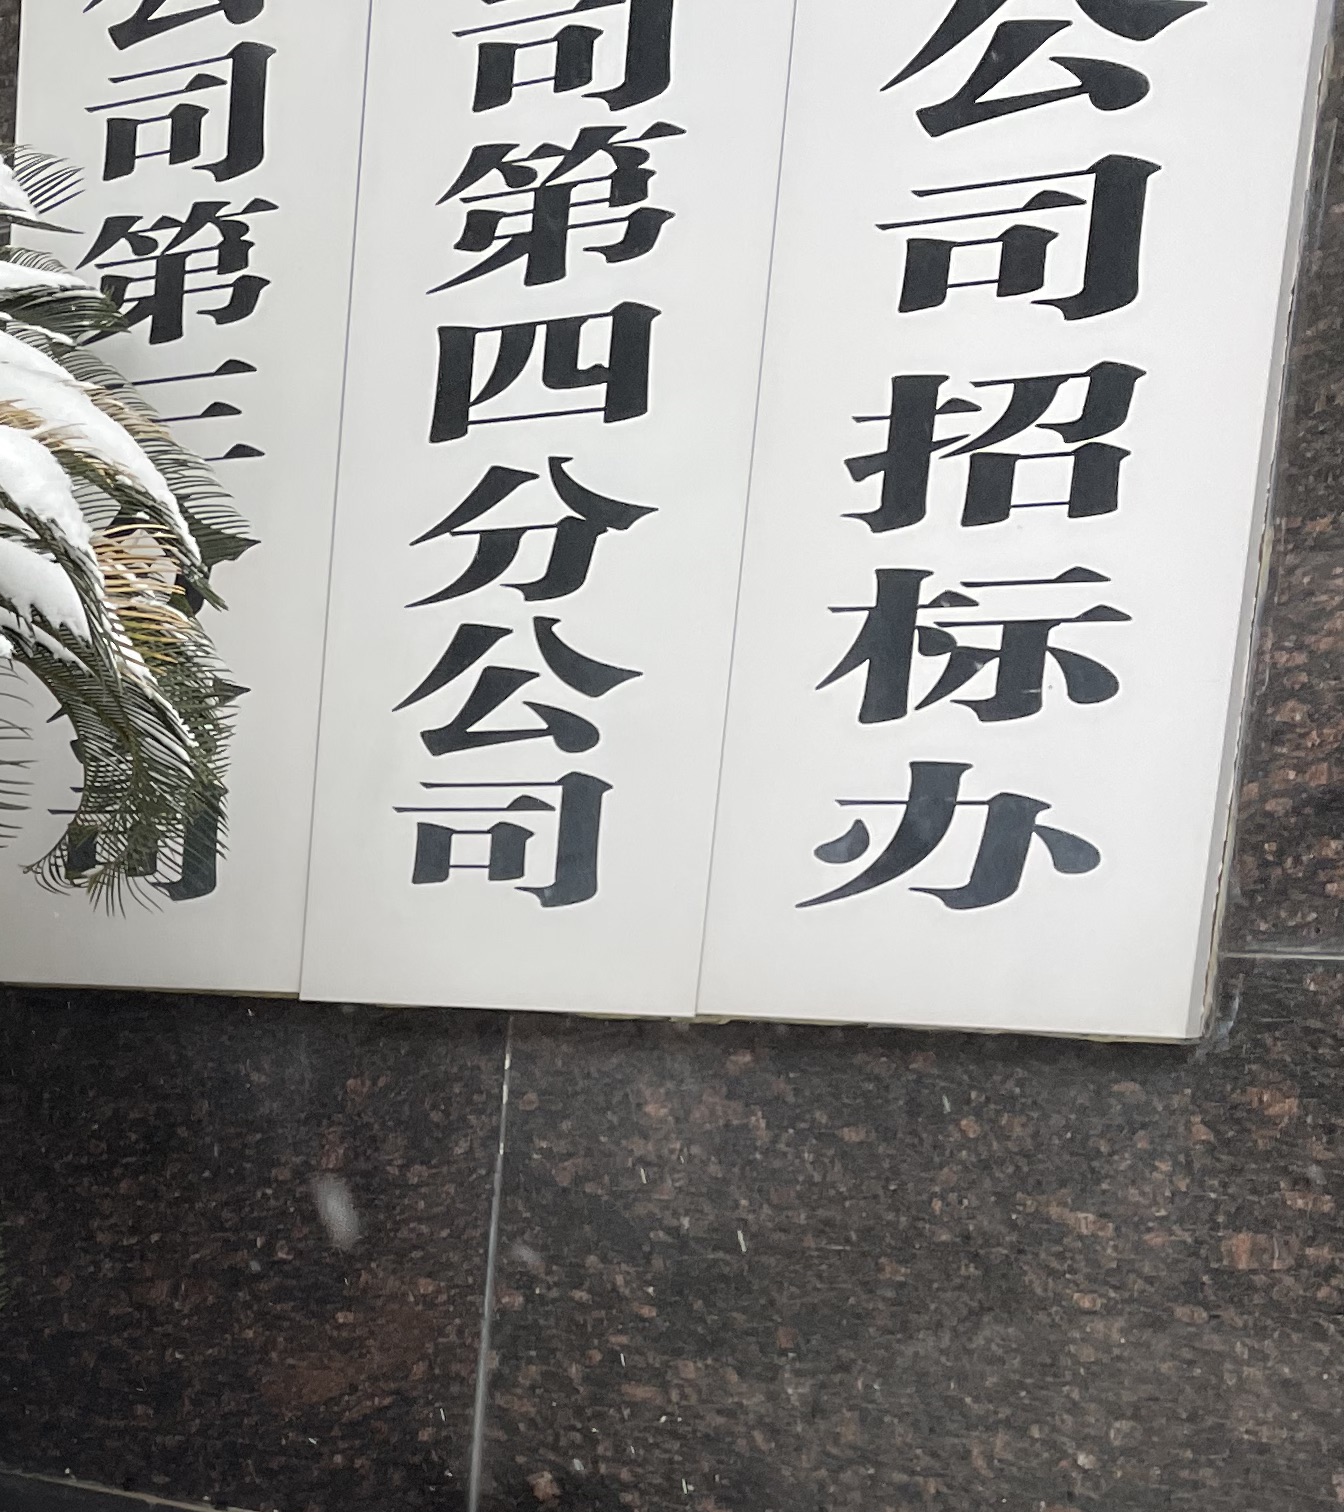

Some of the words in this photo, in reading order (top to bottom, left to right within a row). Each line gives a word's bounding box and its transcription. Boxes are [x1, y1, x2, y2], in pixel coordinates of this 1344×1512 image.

[391, 0, 688, 909] 司第四分公司
[796, 0, 1209, 912] 公司招标办
